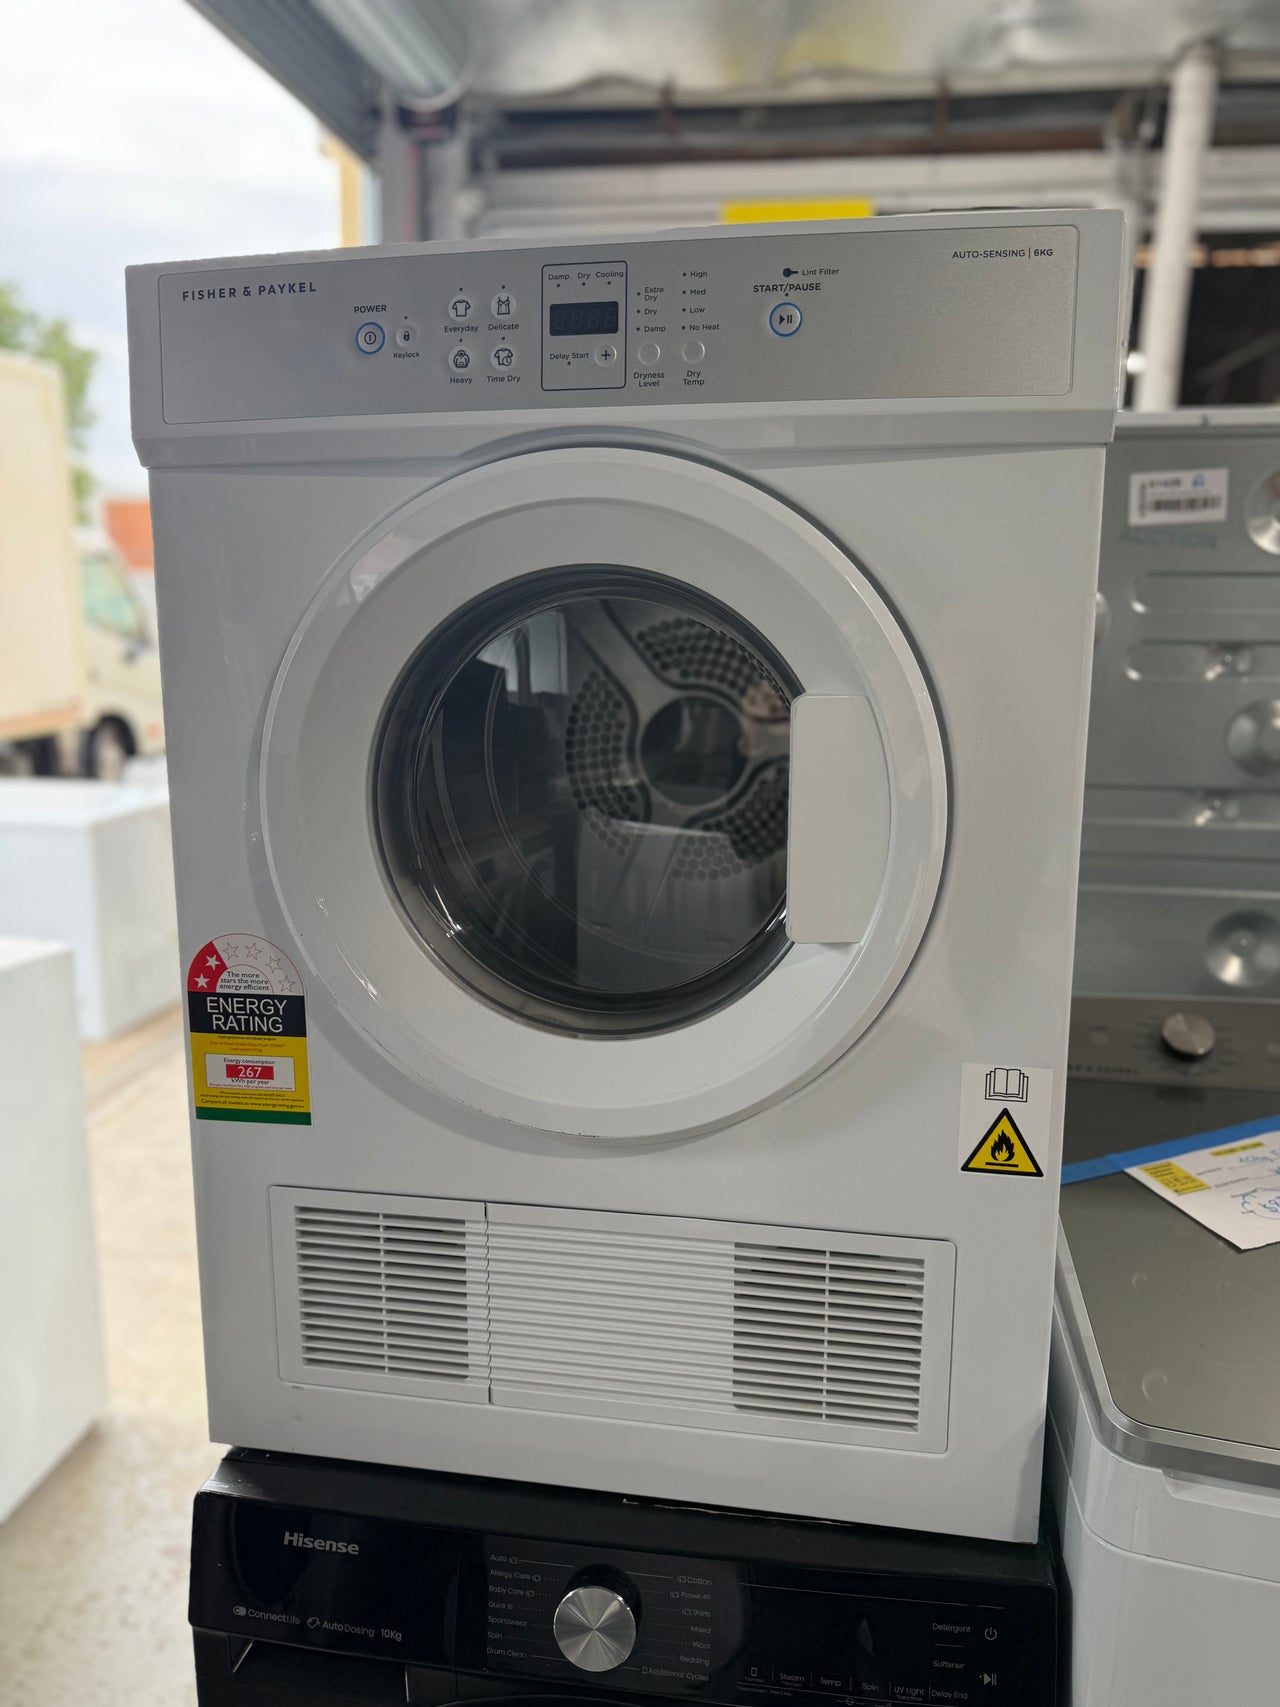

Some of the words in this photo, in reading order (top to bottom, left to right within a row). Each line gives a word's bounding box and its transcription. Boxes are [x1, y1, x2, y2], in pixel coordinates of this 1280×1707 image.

[952, 249, 1025, 259] AUTO-SENSING
[1033, 248, 1053, 257] 6KG
[548, 273, 570, 281] Damp
[577, 271, 591, 280] Dry
[595, 271, 624, 279] Cooling
[182, 287, 237, 301] FISHER
[243, 286, 251, 297] &
[258, 282, 316, 296] PAYKEL
[690, 288, 706, 296] Med
[753, 282, 821, 293] START/PAUSE
[353, 304, 387, 314] POWER
[689, 306, 705, 314] Low
[444, 325, 479, 333] Everyday
[488, 323, 519, 331] Delicate
[644, 325, 666, 333] Damp
[702, 323, 719, 331] Heat
[393, 351, 421, 360] Keylock
[549, 353, 570, 361] Delay
[487, 375, 505, 383] Time
[507, 374, 521, 383] Dry
[633, 371, 665, 380] Dryness
[687, 370, 701, 378] Dry
[450, 376, 472, 385] Heavy
[683, 378, 705, 386] Temp
[206, 997, 287, 1015] ENERGY
[212, 1014, 283, 1033] RATING
[223, 1057, 241, 1065] Energy
[238, 1065, 262, 1078] 267
[283, 1531, 359, 1555] Hisense
[490, 1569, 512, 1579] Allergy
[507, 1587, 524, 1596] Care
[248, 1608, 300, 1625] ConnectLife
[488, 1616, 528, 1627] Sportswear
[932, 1622, 971, 1634] Detergent
[381, 1628, 402, 1642] 10Kg
[487, 1631, 502, 1640] Spin
[486, 1647, 505, 1656] Drum
[506, 1649, 527, 1658] Clean
[933, 1659, 965, 1669] Softener
[779, 1672, 805, 1682] Steam
[820, 1677, 842, 1687] Temp
[862, 1682, 879, 1692] Spin
[894, 1686, 905, 1694] UV
[905, 1687, 925, 1697] Light
[931, 1689, 952, 1699] Delay
[953, 1691, 968, 1699] End
